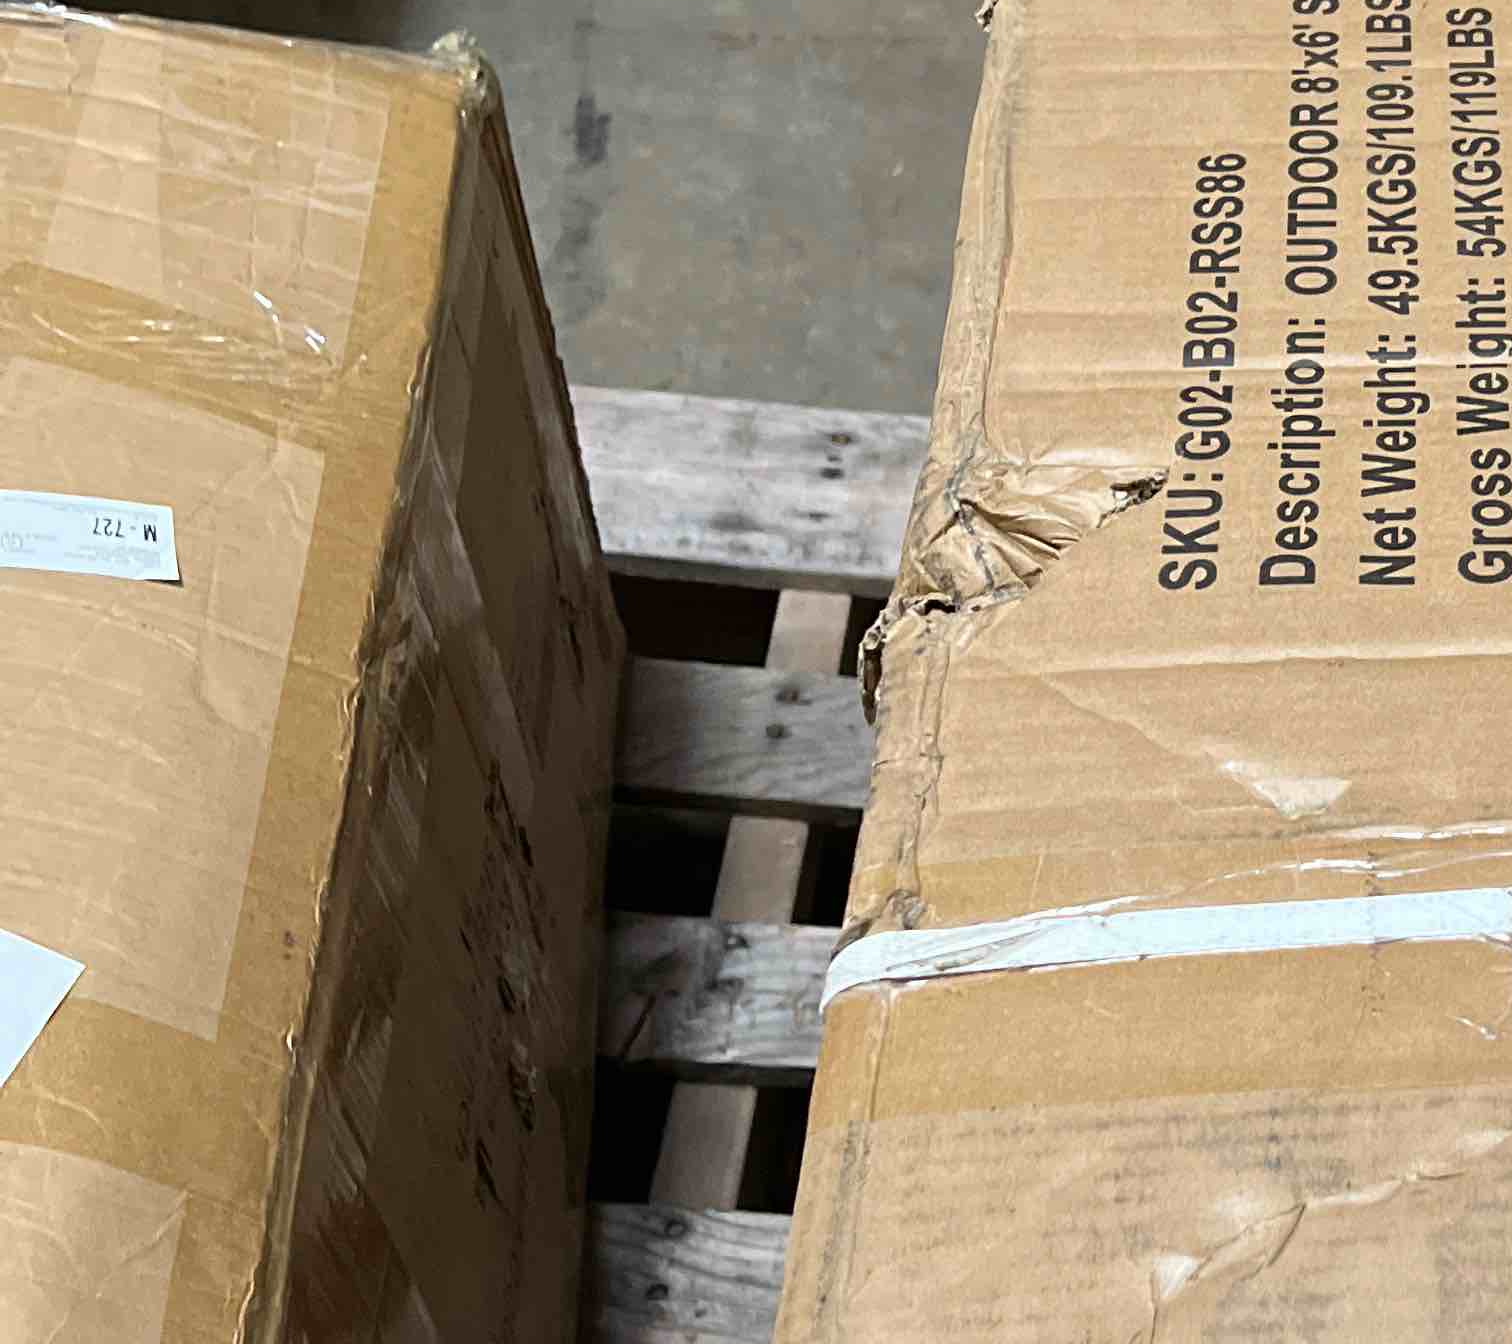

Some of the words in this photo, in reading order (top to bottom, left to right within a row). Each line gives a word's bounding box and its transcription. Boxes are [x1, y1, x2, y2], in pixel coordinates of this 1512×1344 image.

[1284, 100, 1339, 296] OUTDOOR
[1445, 7, 1507, 258] 54KGS/119LBS
[1258, 318, 1334, 586] Description:
[1360, 334, 1431, 498] Weight:
[92, 516, 126, 540] 727
[1358, 506, 1417, 586] Net
